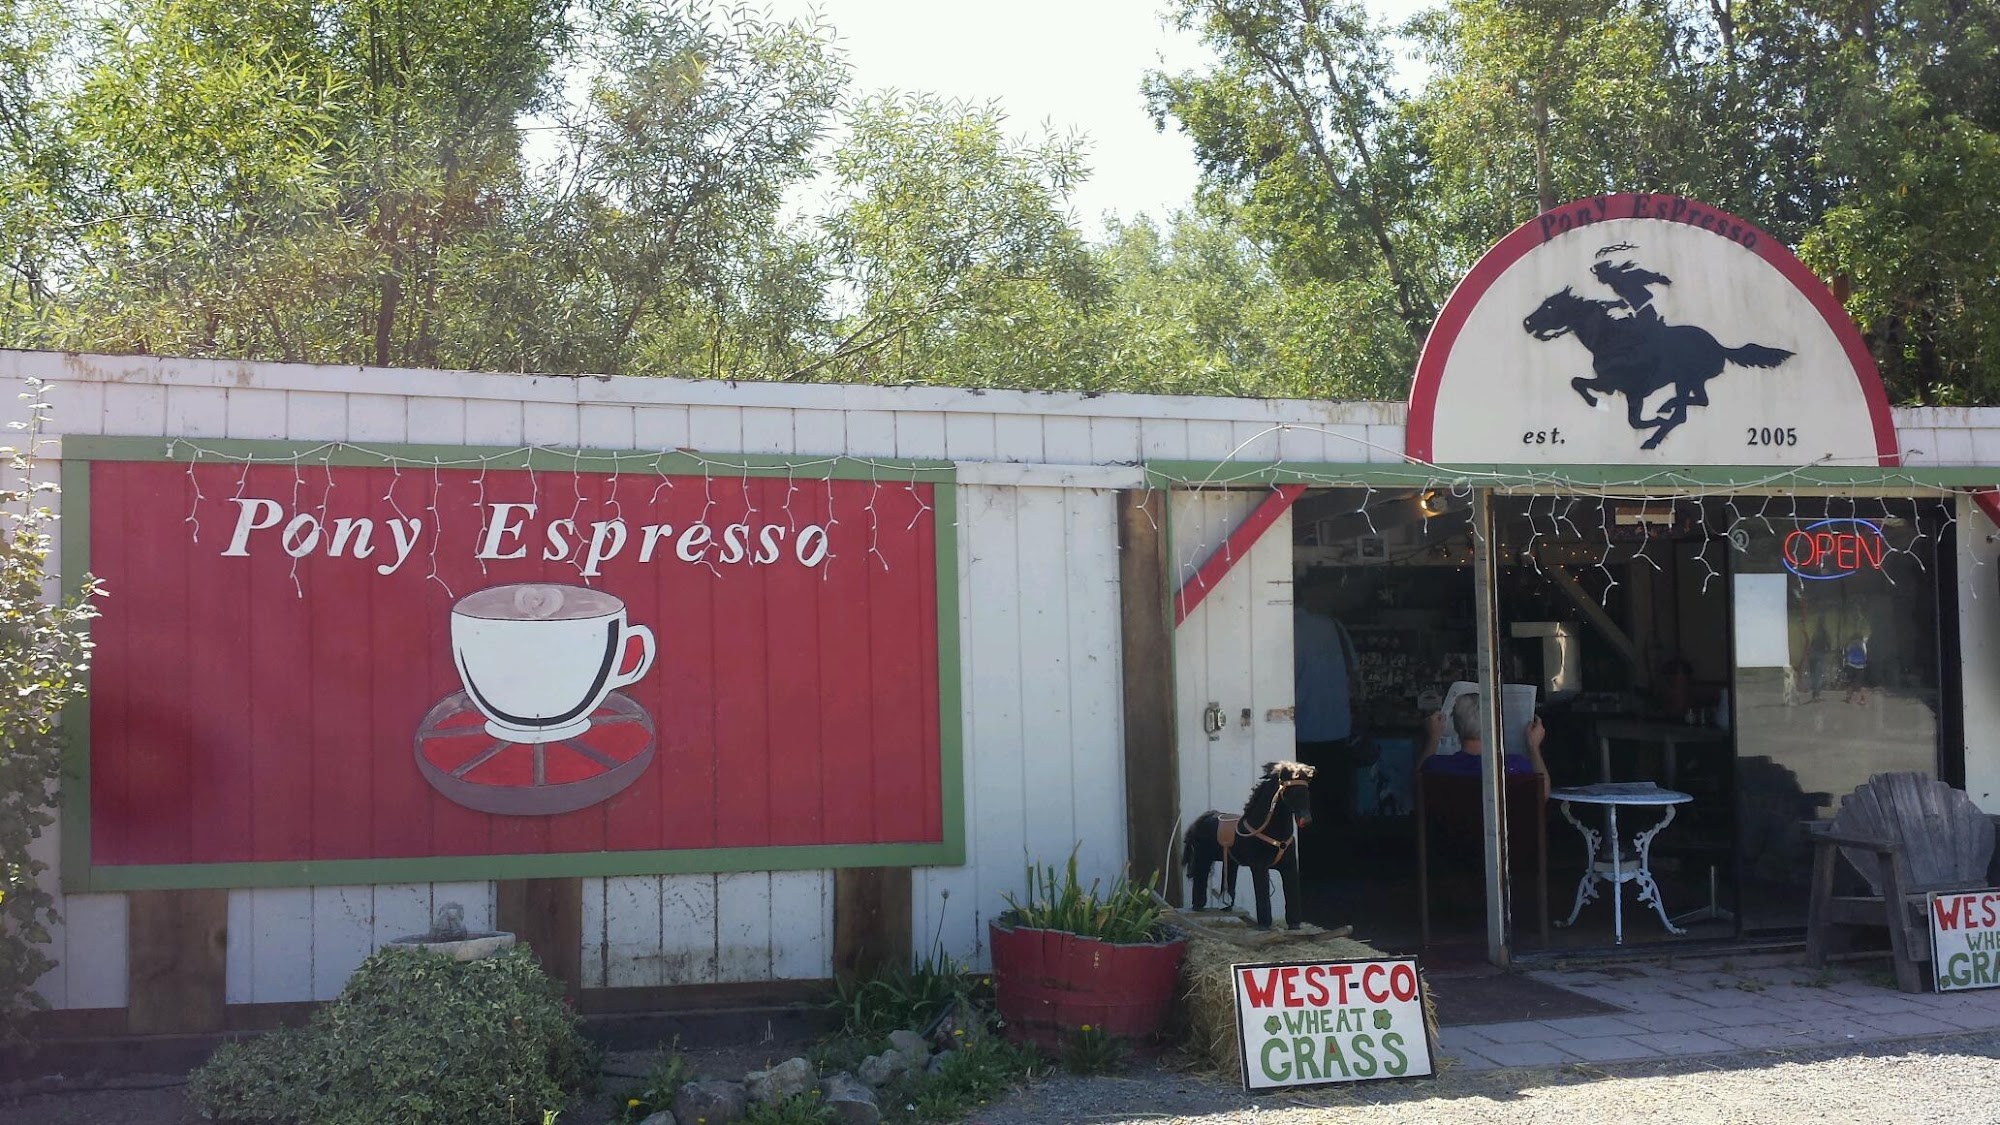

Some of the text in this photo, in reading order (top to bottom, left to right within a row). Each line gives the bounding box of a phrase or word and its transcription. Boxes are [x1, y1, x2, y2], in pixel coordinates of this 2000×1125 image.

[1540, 196, 1606, 242] Pony
[1522, 427, 1798, 446] est. 2005
[220, 498, 829, 577] Pony Espresso
[1784, 530, 1881, 570] OPEN
[1934, 895, 2000, 931] WES
[1242, 963, 1419, 1008] WEST-CO.
[1282, 1008, 1366, 1035] WHEAT
[1260, 1032, 1408, 1082] GRASS
